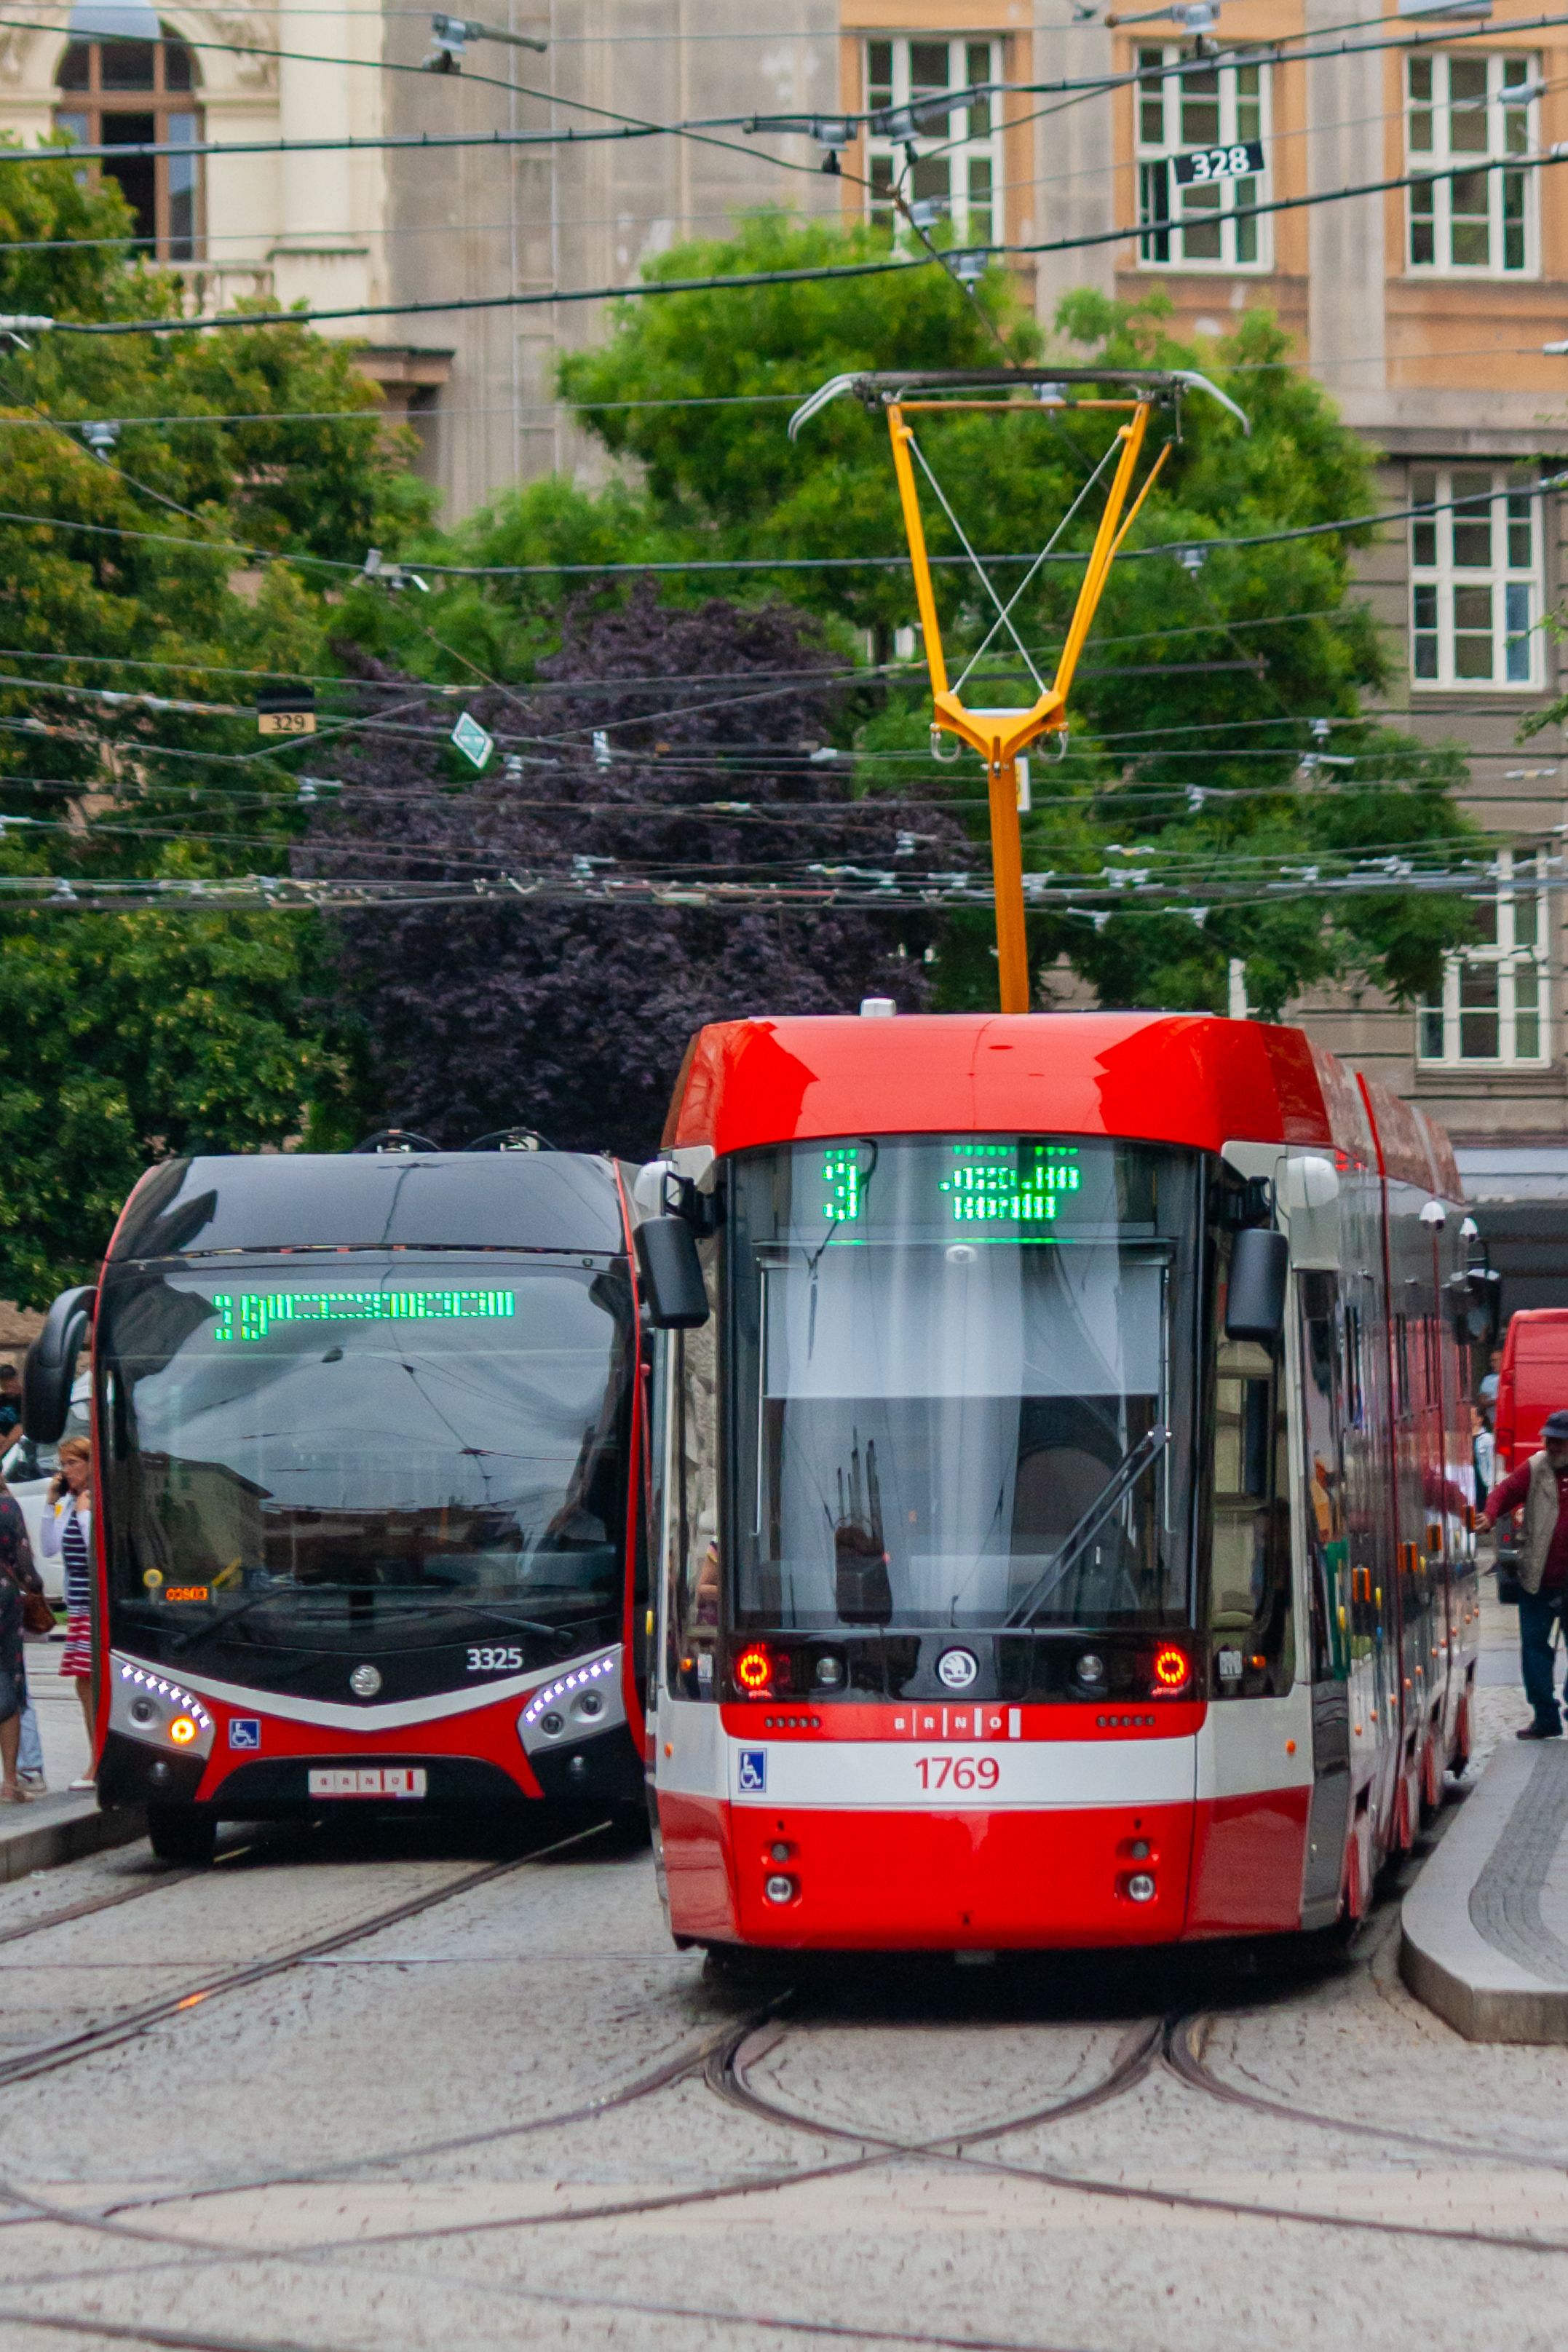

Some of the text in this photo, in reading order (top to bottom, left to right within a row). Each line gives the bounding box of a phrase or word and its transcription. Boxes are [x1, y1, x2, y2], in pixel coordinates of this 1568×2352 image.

[1190, 146, 1250, 180] 328
[271, 714, 305, 731] 329
[466, 1647, 523, 1670] 3325
[914, 1757, 1000, 1790] 1769
